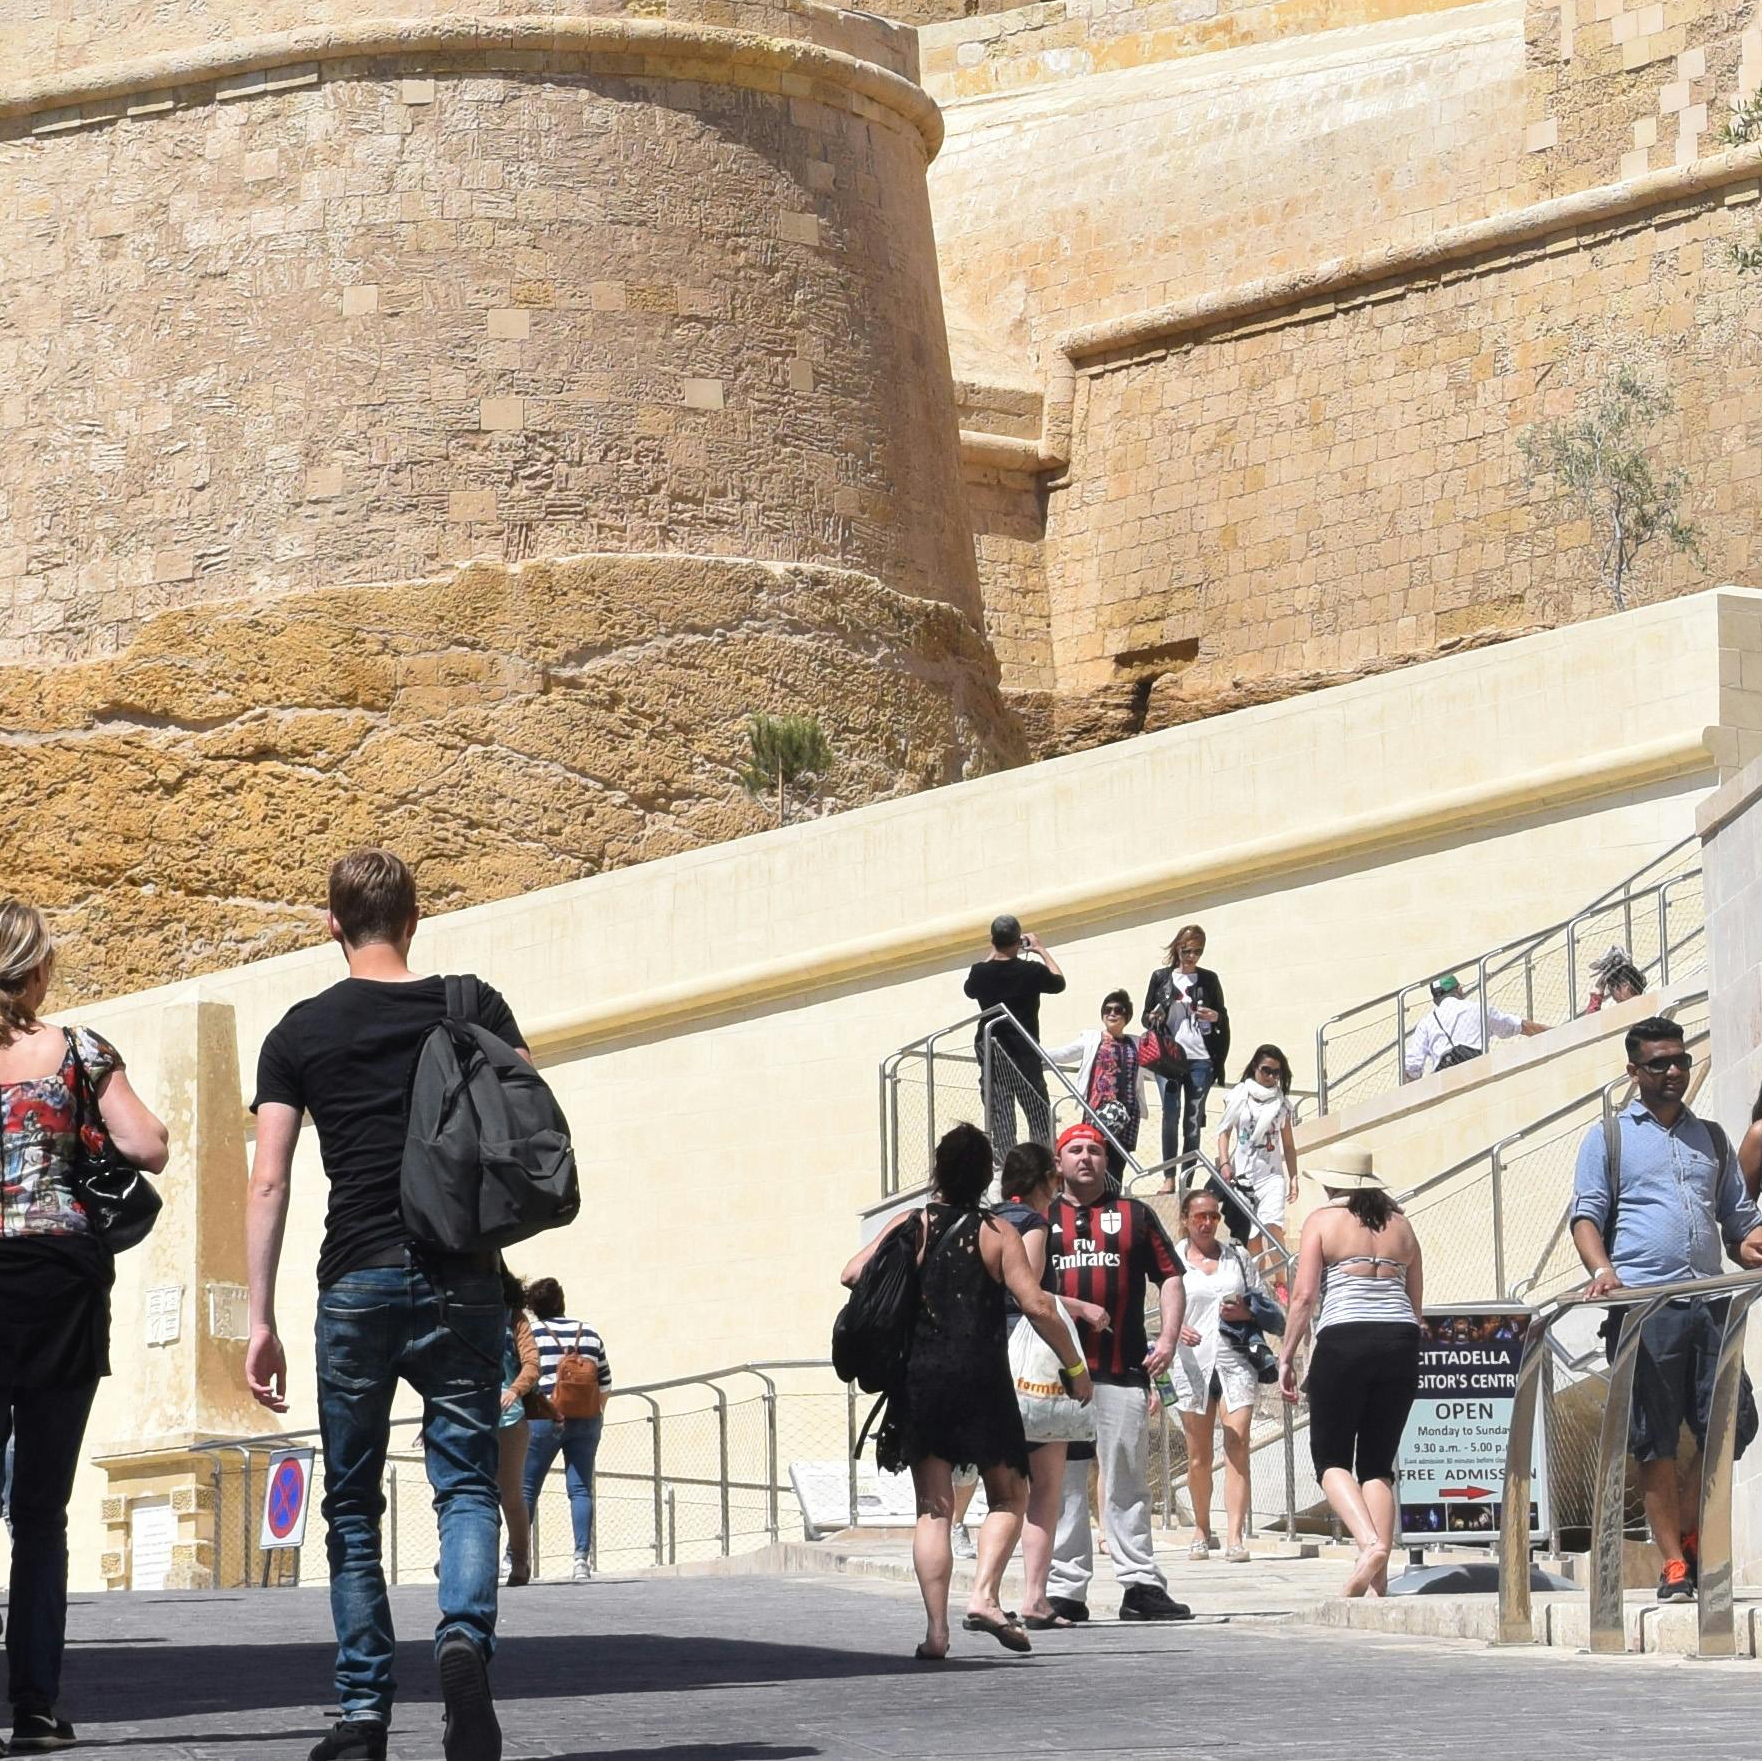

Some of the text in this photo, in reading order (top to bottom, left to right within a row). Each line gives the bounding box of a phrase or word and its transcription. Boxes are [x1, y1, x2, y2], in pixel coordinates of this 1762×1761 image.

[1073, 1238, 1096, 1252] Fly
[1052, 1250, 1120, 1270] Emirates
[1417, 1374, 1467, 1389] SITOR'S
[1435, 1403, 1494, 1420] OPEN
[1418, 1425, 1460, 1438] Monday
[1463, 1427, 1473, 1436] to
[1413, 1443, 1436, 1453] 9.30
[1470, 1442, 1493, 1453] 5.00
[1398, 1468, 1537, 1481] FREE ADMISSN
